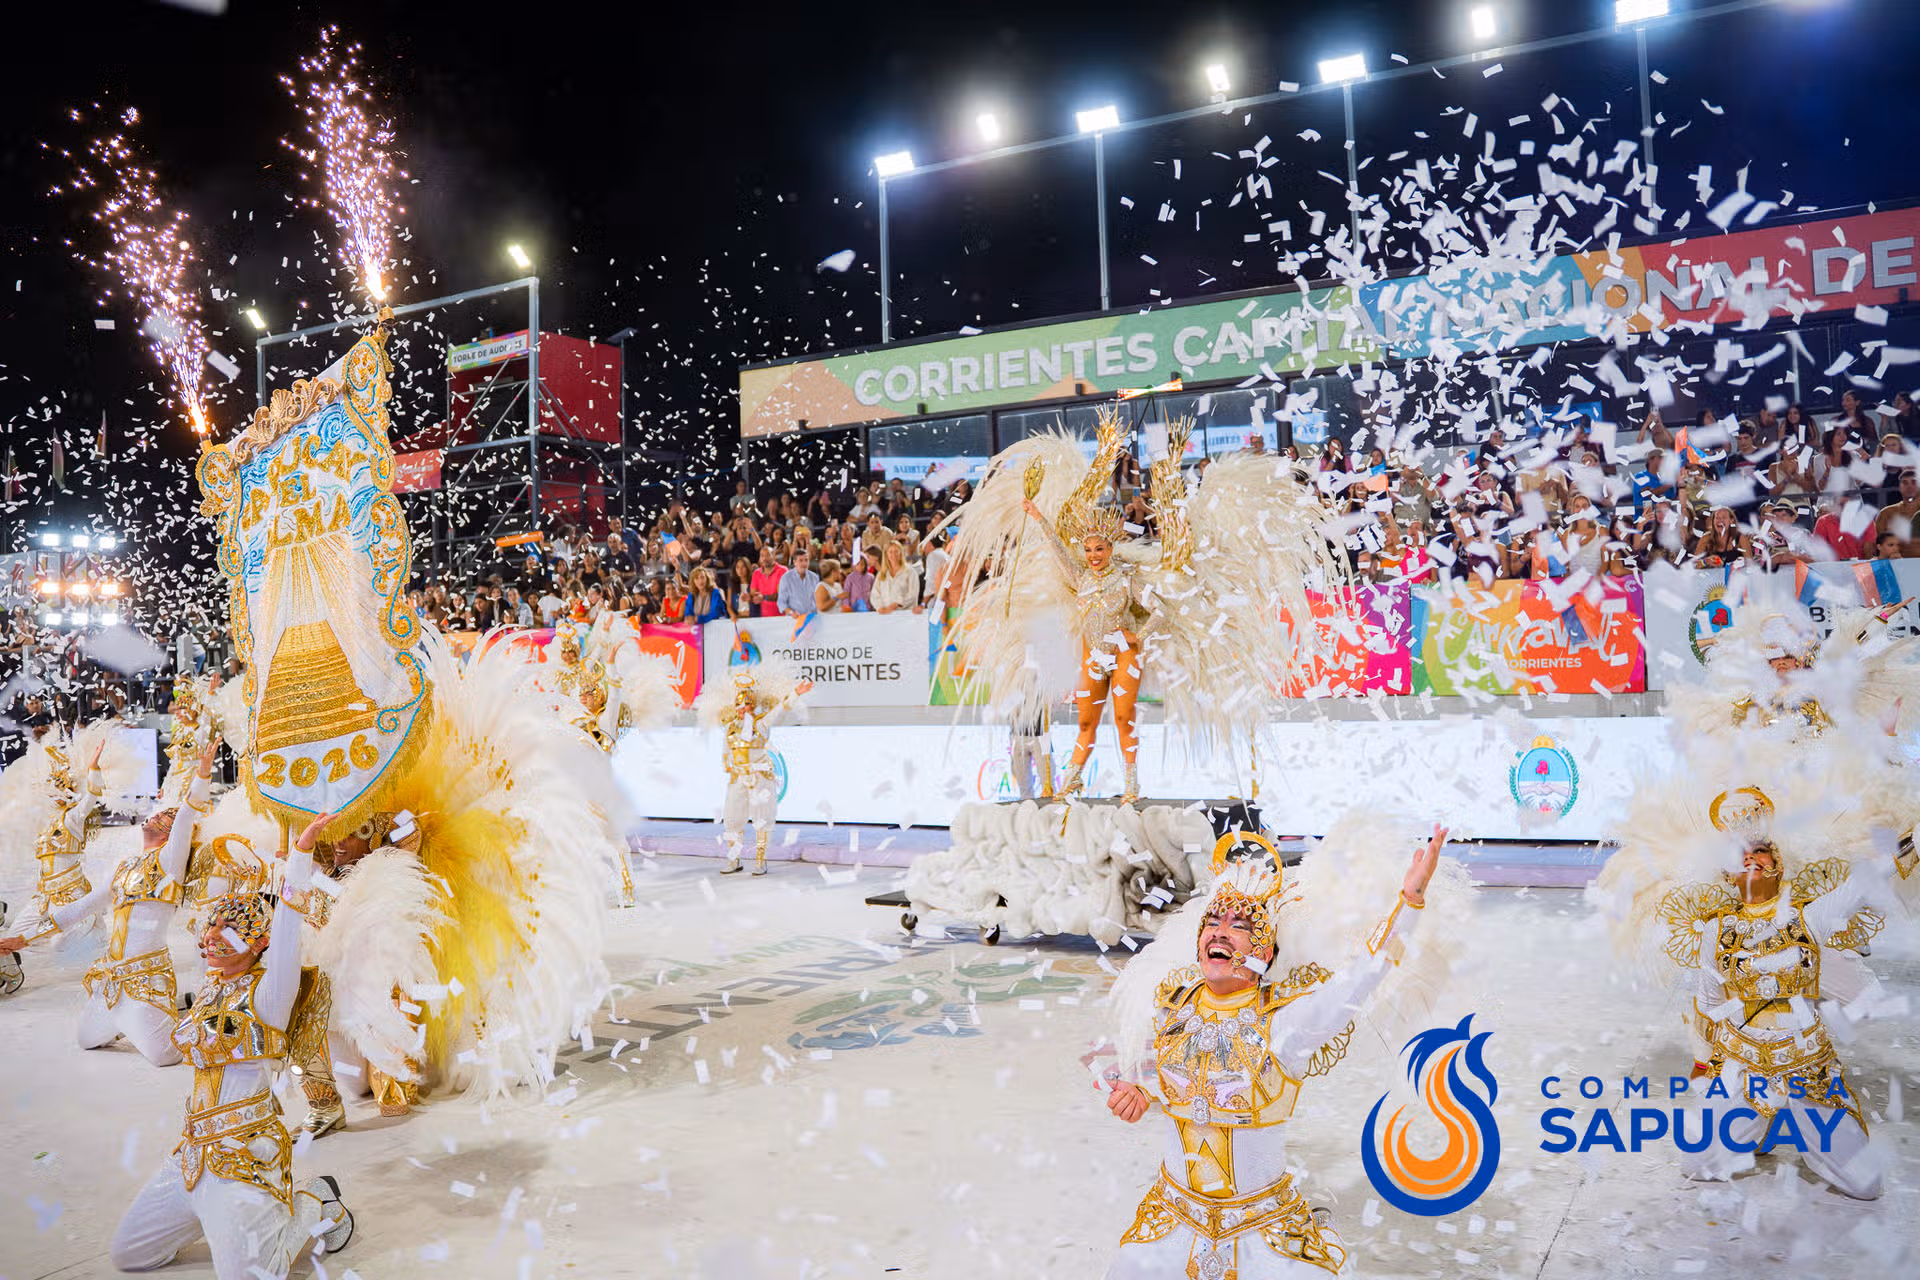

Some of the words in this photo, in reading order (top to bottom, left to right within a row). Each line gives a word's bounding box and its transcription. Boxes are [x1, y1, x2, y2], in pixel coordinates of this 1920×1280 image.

[854, 332, 1157, 406] CORRIENTES
[1811, 236, 1918, 296] DE
[477, 349, 488, 358] DE
[852, 646, 873, 659] DE
[256, 733, 379, 788] 2026
